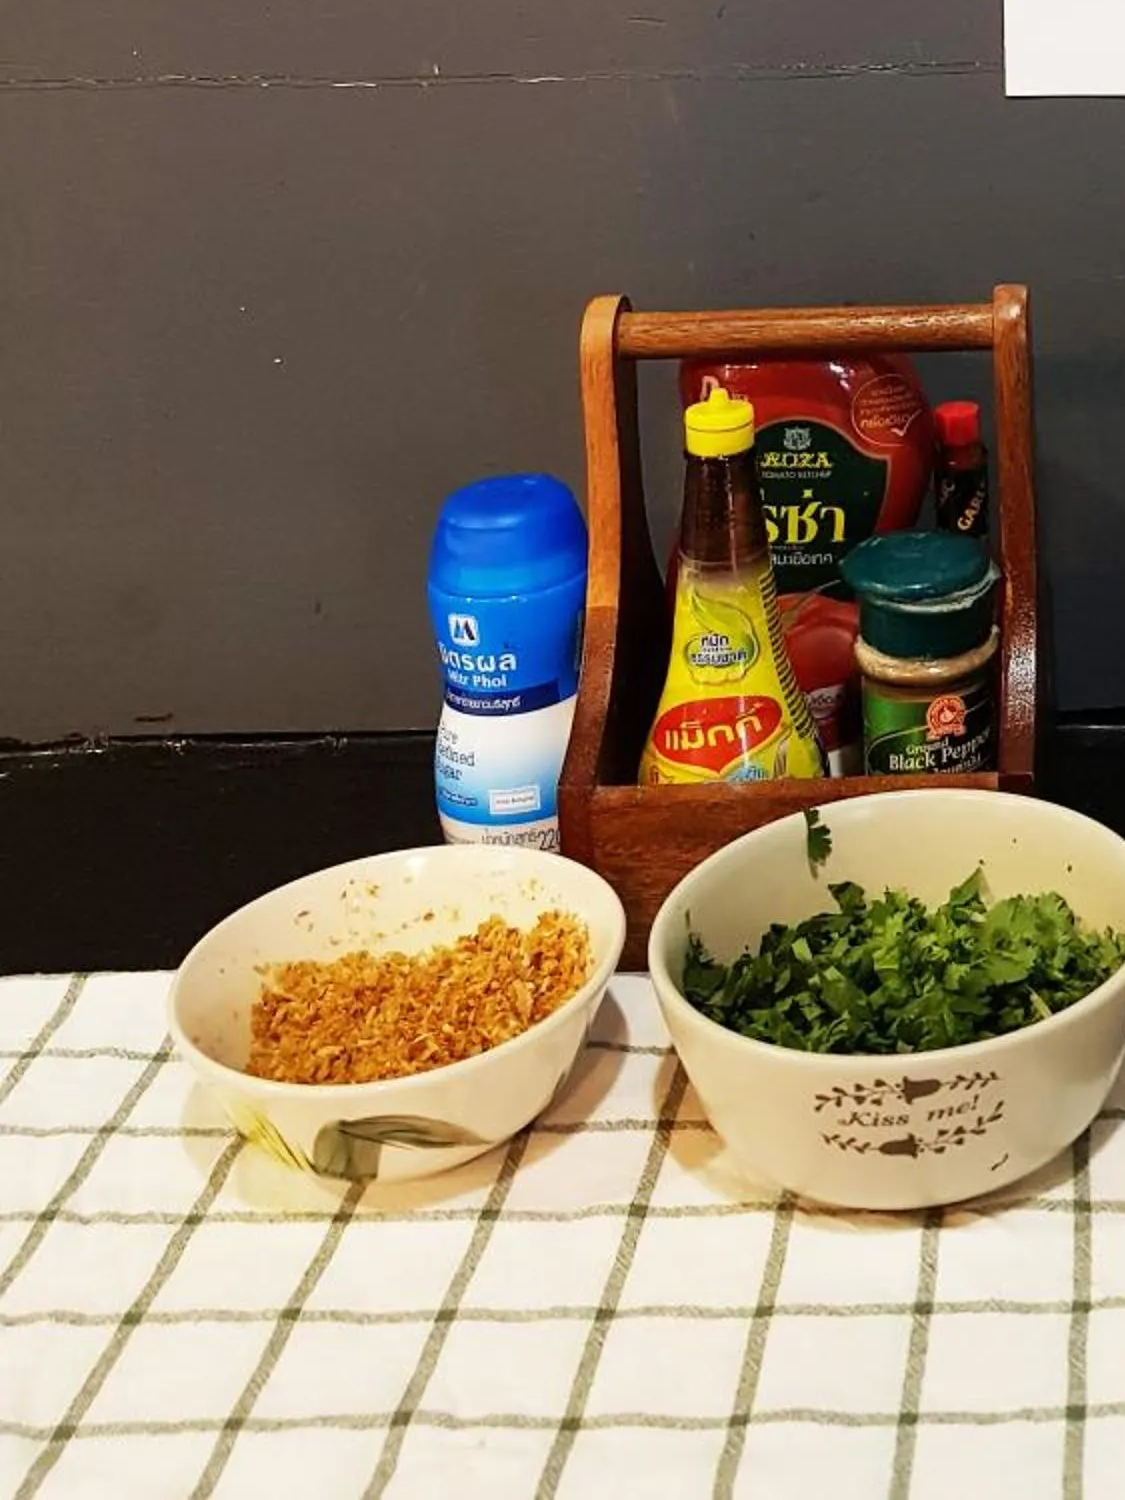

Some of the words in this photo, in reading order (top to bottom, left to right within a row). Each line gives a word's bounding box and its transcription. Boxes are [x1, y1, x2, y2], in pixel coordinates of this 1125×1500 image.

[761, 487, 846, 544] รซ่า
[889, 753, 935, 770] Black
[838, 1110, 910, 1128] Kiss
[926, 1093, 980, 1122] me!
